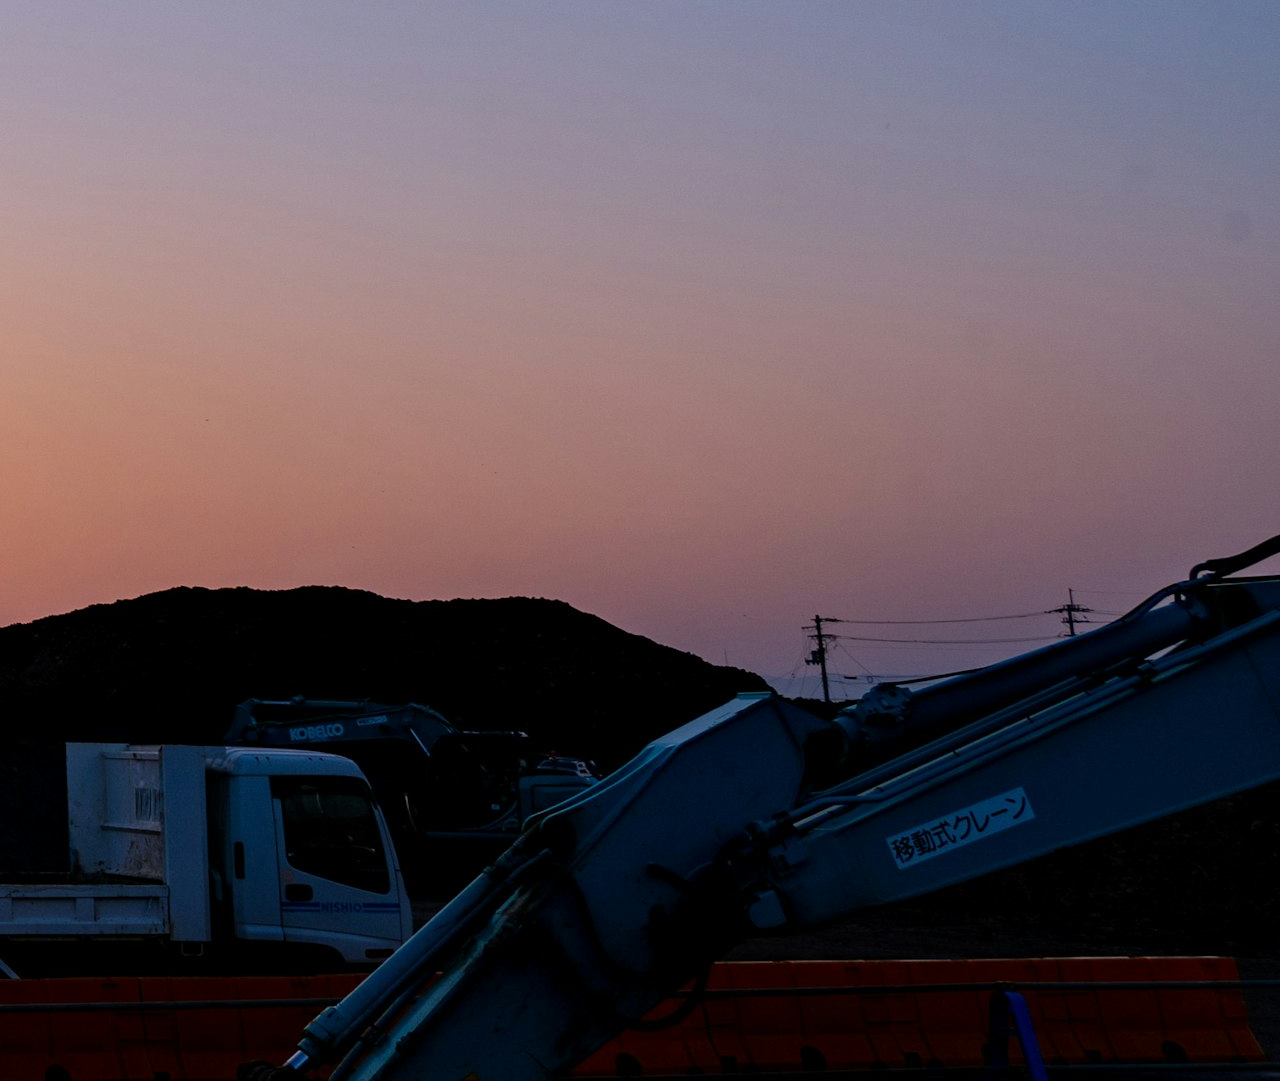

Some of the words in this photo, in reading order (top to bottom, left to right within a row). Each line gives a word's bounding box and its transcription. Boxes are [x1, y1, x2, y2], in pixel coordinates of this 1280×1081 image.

[289, 723, 344, 741] KOBELCO
[891, 796, 1026, 863] 移動式クレーン
[321, 902, 362, 913] NISHIO
